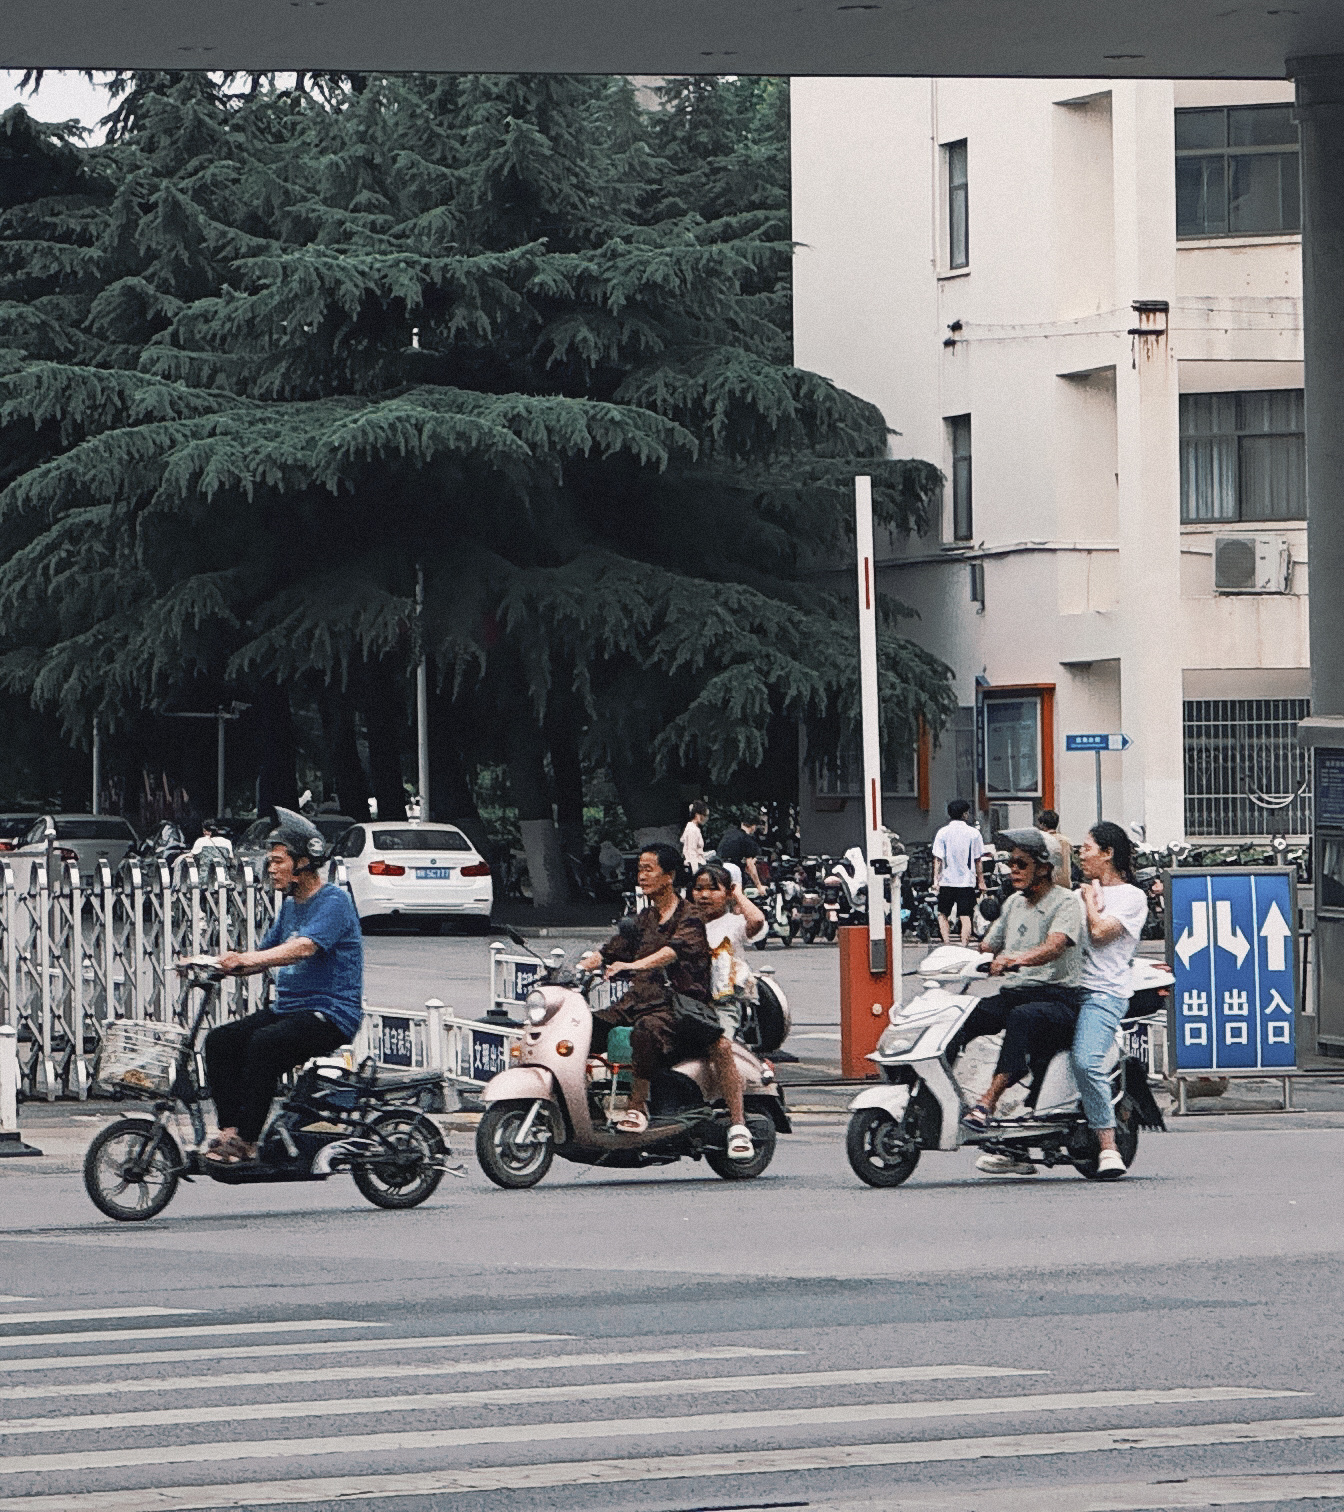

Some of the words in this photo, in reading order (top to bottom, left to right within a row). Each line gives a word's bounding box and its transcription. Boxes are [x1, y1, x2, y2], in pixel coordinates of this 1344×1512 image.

[1182, 989, 1209, 1046] 出口
[1223, 988, 1249, 1045] 出口
[1264, 989, 1292, 1044] 入口
